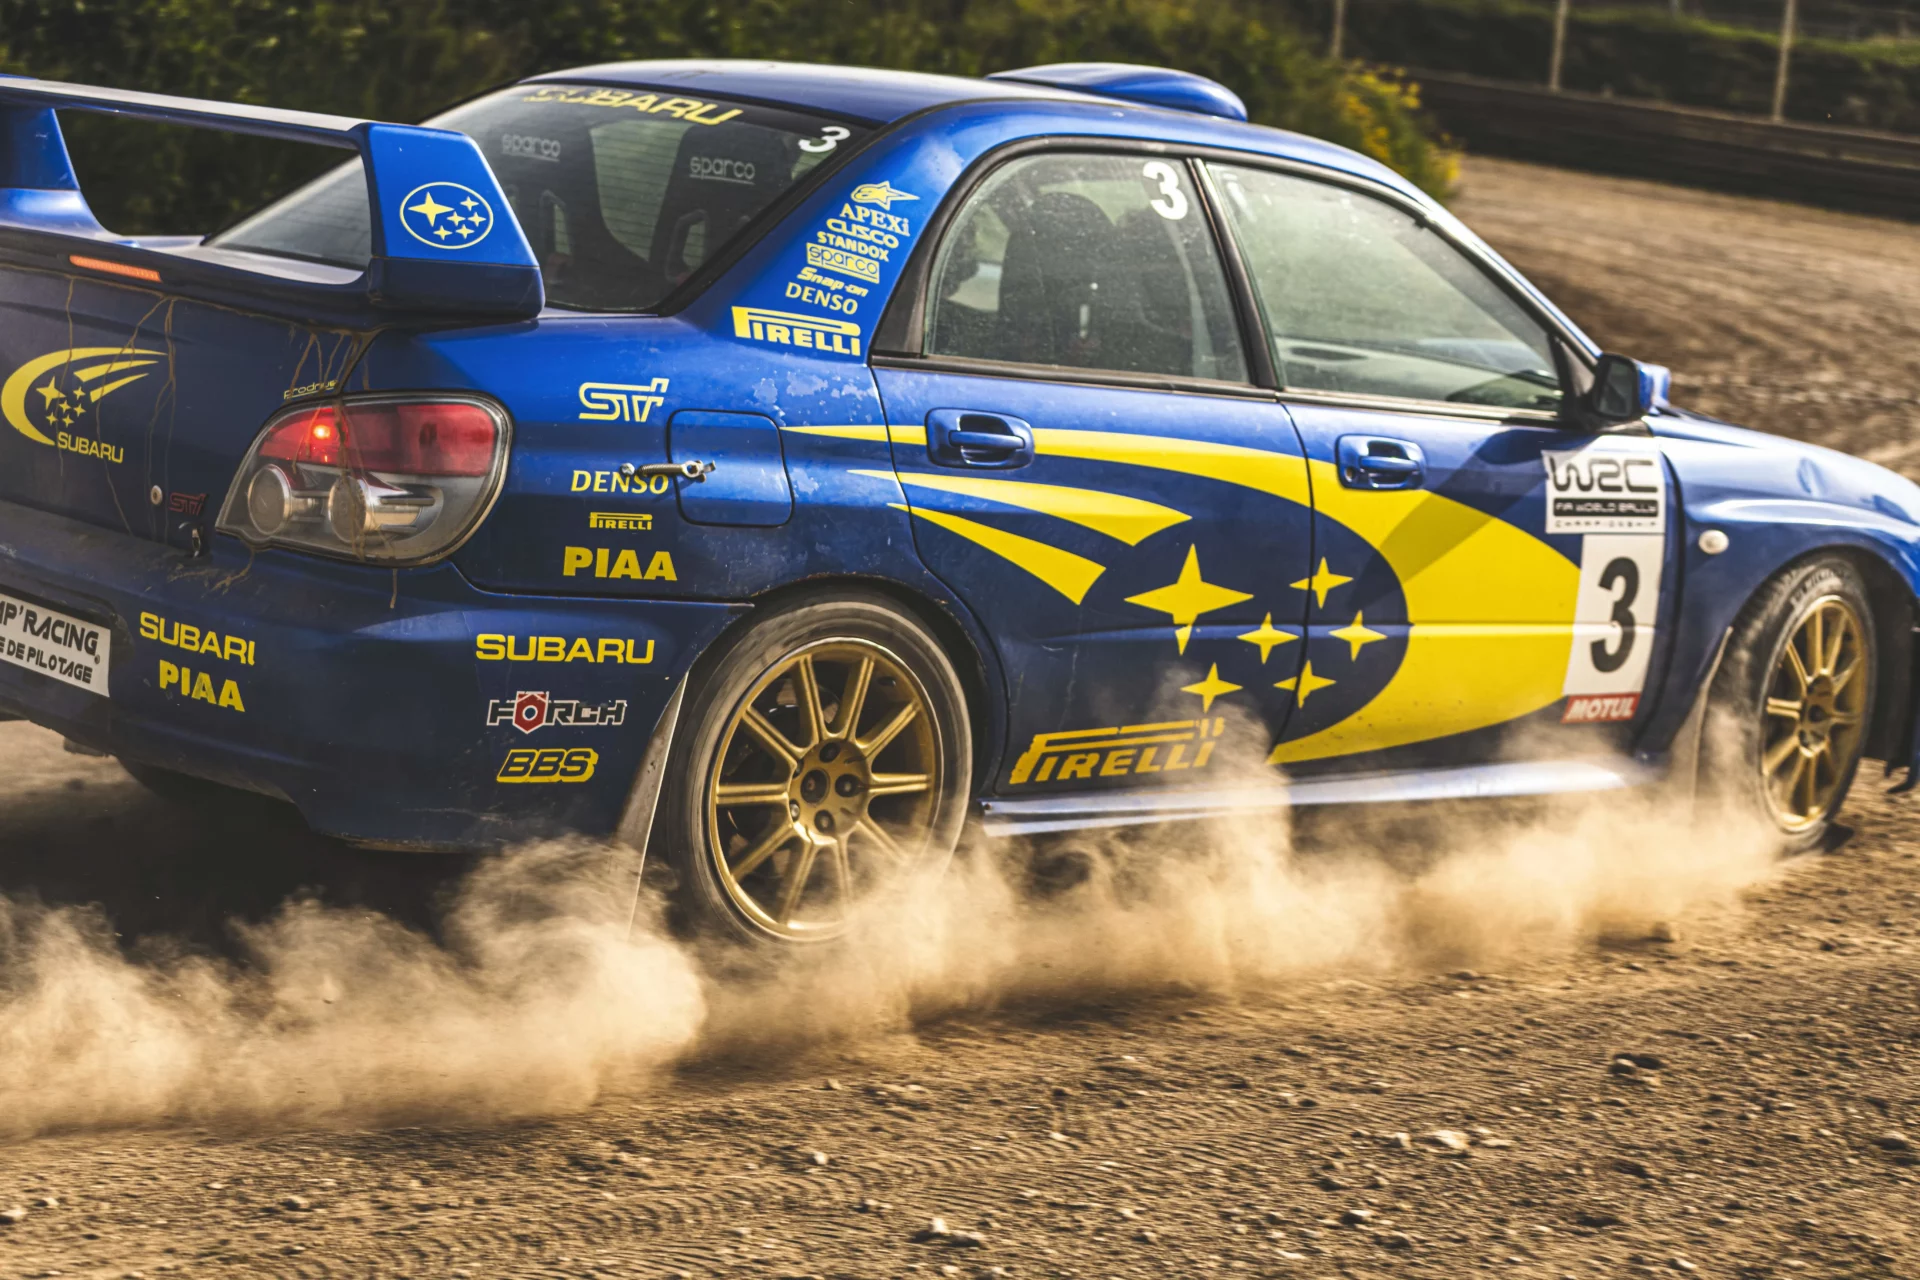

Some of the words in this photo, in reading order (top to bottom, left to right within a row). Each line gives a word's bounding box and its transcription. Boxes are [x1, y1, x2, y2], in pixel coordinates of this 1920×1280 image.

[523, 87, 744, 126] SUBARU
[502, 133, 561, 160] sparco
[798, 125, 851, 153] 3
[689, 156, 755, 182] sparco
[1142, 161, 1189, 221] 3
[816, 231, 890, 262] STANDOX
[826, 218, 900, 249] CUSCO
[808, 246, 879, 278] sparco
[796, 266, 869, 298] Snap-on
[785, 282, 859, 316] DENSO
[731, 306, 862, 357] PIRELLI
[57, 431, 124, 464] SUBARU
[570, 469, 670, 495] DENSO
[589, 512, 653, 531] PIRELLI
[563, 546, 678, 582] PIAA
[1589, 556, 1640, 674] 3
[6, 639, 26, 661] DE
[26, 645, 93, 685] PILOTAGE
[476, 633, 655, 664] SUBARU
[159, 659, 246, 713] PIAA
[1566, 697, 1635, 721] MOTUL
[496, 748, 600, 784] BBS
[1009, 716, 1225, 785] PIRELLI
